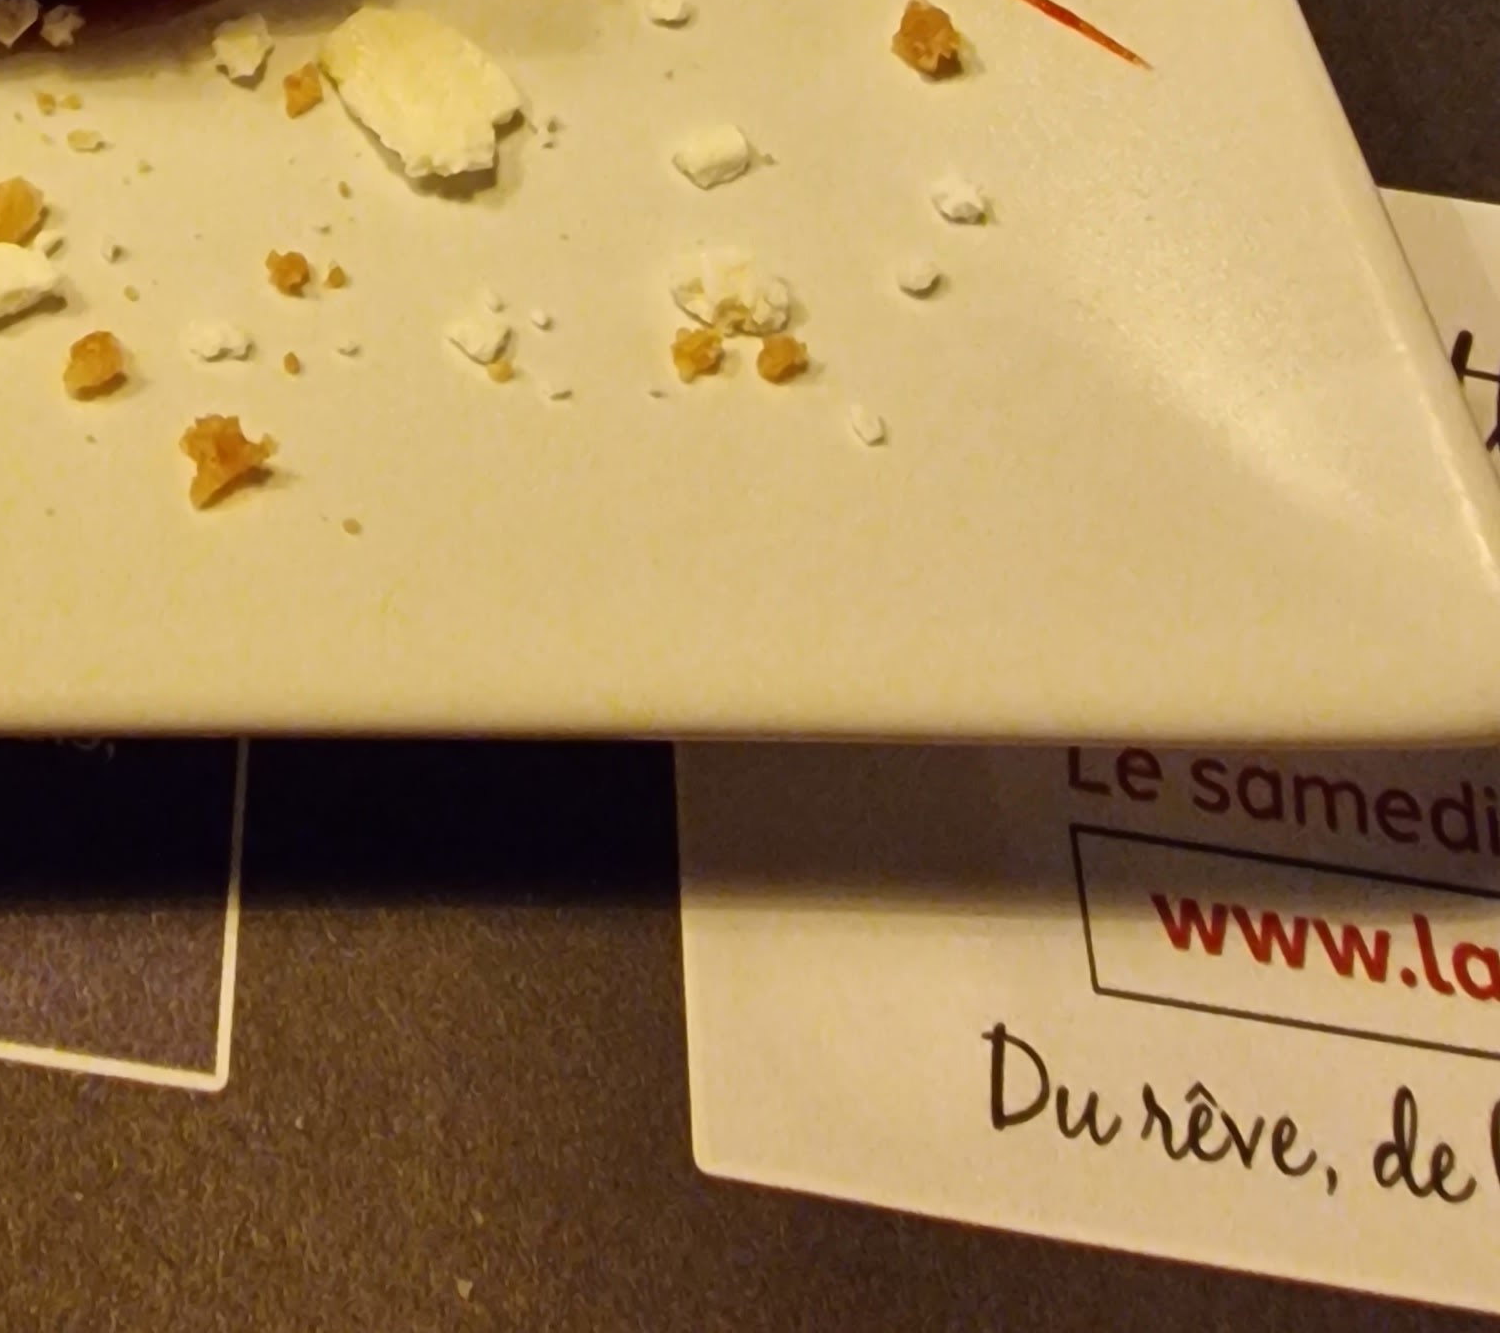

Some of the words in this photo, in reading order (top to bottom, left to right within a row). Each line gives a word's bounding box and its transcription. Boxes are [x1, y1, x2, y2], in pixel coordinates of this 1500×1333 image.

[1067, 745, 1164, 801] Le
[981, 1023, 1122, 1146] Du
[1140, 1082, 1338, 1196] rêve,
[1373, 1085, 1478, 1204] de
